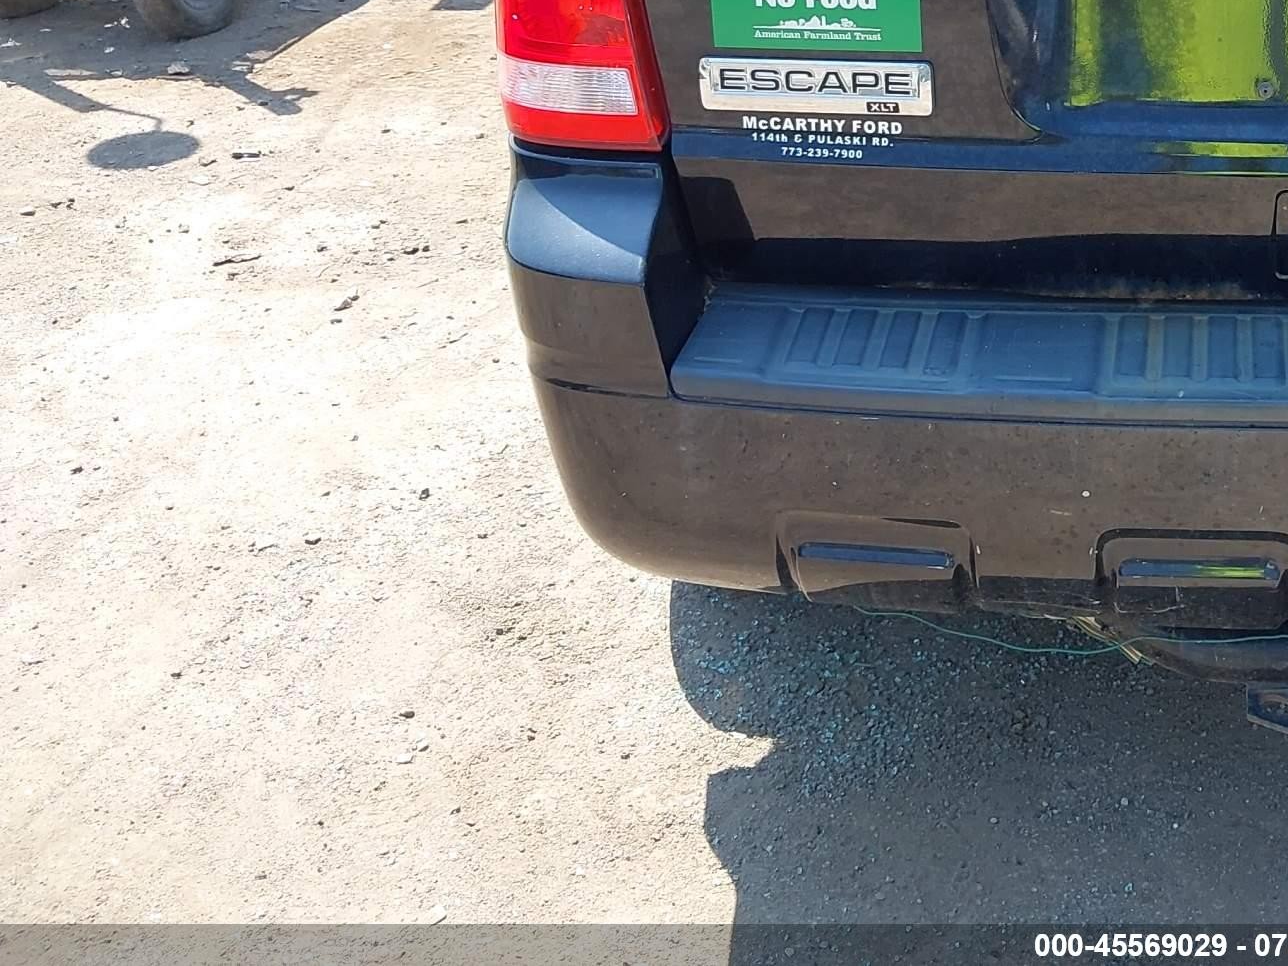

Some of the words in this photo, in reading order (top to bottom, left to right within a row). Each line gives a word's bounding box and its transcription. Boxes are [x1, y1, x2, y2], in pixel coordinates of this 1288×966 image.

[754, 30, 801, 39] American
[804, 31, 851, 41] Farmland
[855, 33, 882, 41] Trust
[719, 68, 912, 96] ESCAPE
[869, 103, 897, 112] XLT
[742, 116, 846, 133] McCARTHY
[852, 120, 903, 134] FORD
[752, 133, 789, 143] 114th
[794, 133, 802, 143] &
[808, 134, 867, 146] PULASKI
[872, 137, 894, 147] RD.
[781, 146, 863, 159] 773-239-7900
